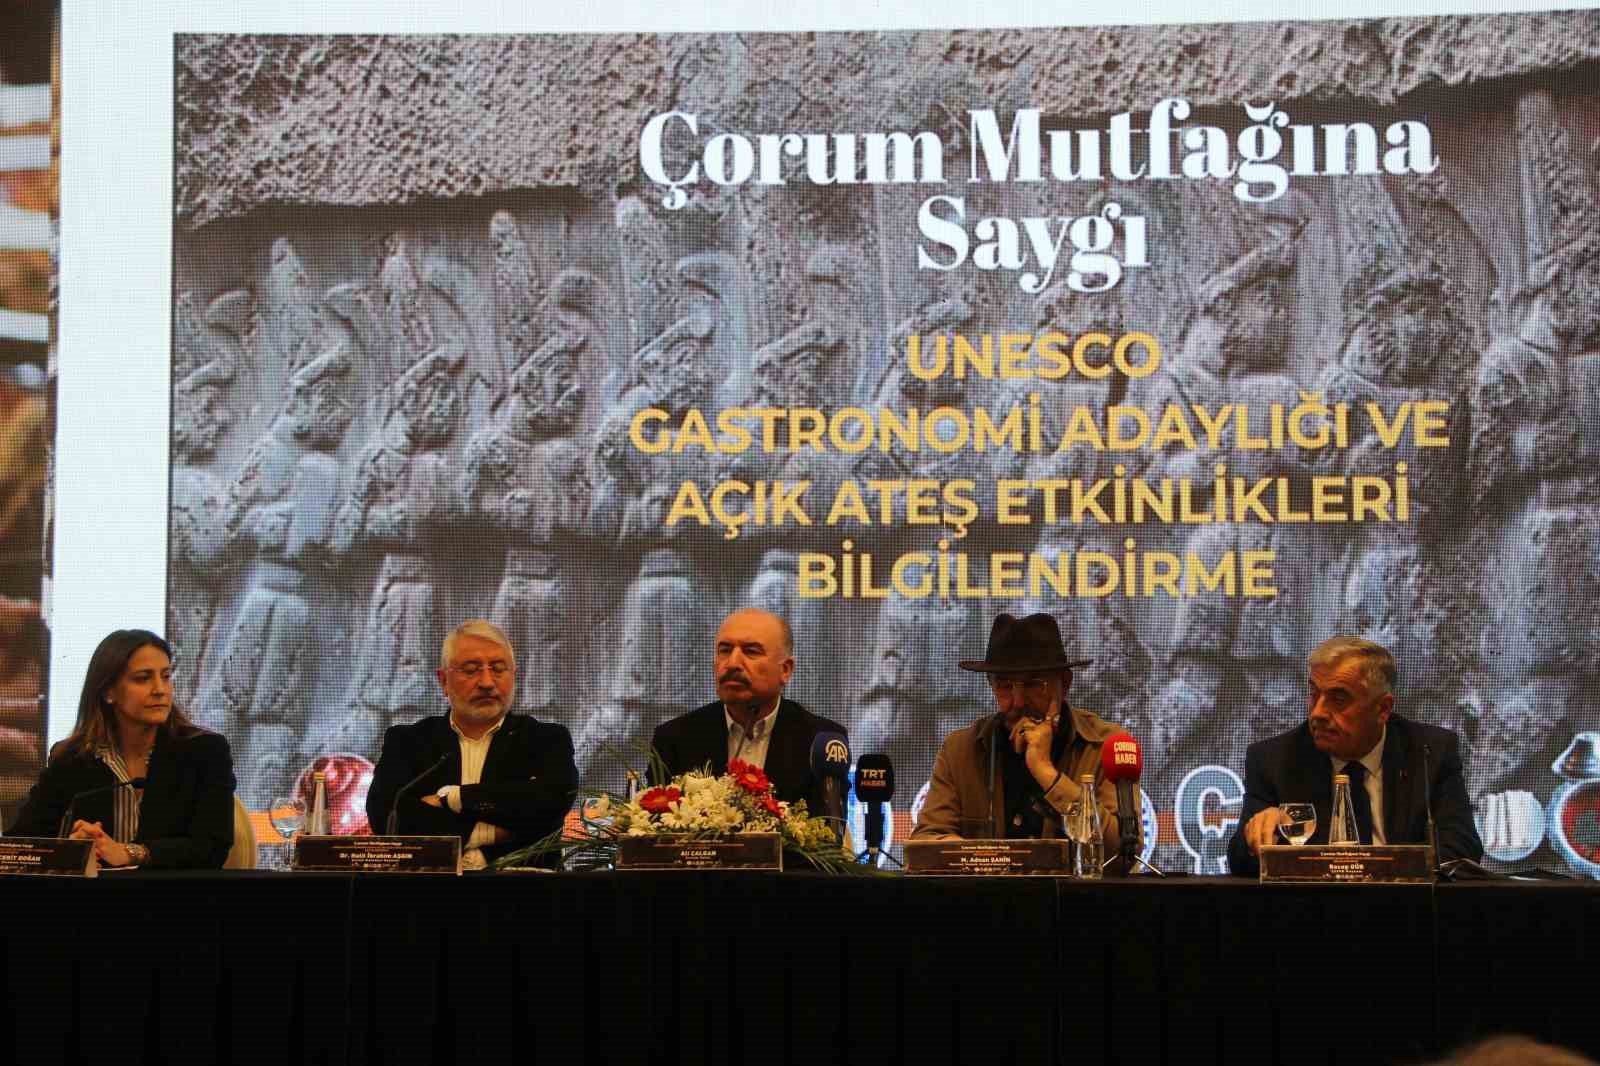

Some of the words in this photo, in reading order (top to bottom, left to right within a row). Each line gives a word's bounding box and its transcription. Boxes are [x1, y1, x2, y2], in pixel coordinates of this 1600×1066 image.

[639, 111, 946, 209] Çorum
[968, 98, 1439, 202] Mutfağına
[917, 195, 1150, 293] Saygı
[906, 331, 1162, 381] UNESCO
[629, 392, 1042, 454] GASTRONOMİ
[1058, 390, 1350, 452] ADAYLIĞI
[1366, 400, 1450, 449] VE
[665, 479, 812, 540] AÇIK
[826, 479, 979, 539] ATEŞ
[997, 461, 1409, 526] ETKİNLİKLERİ
[799, 537, 1280, 600] BİLGİLENDİRME
[825, 740, 849, 764] AA
[860, 768, 887, 780] TRT
[1114, 752, 1137, 765] HABER
